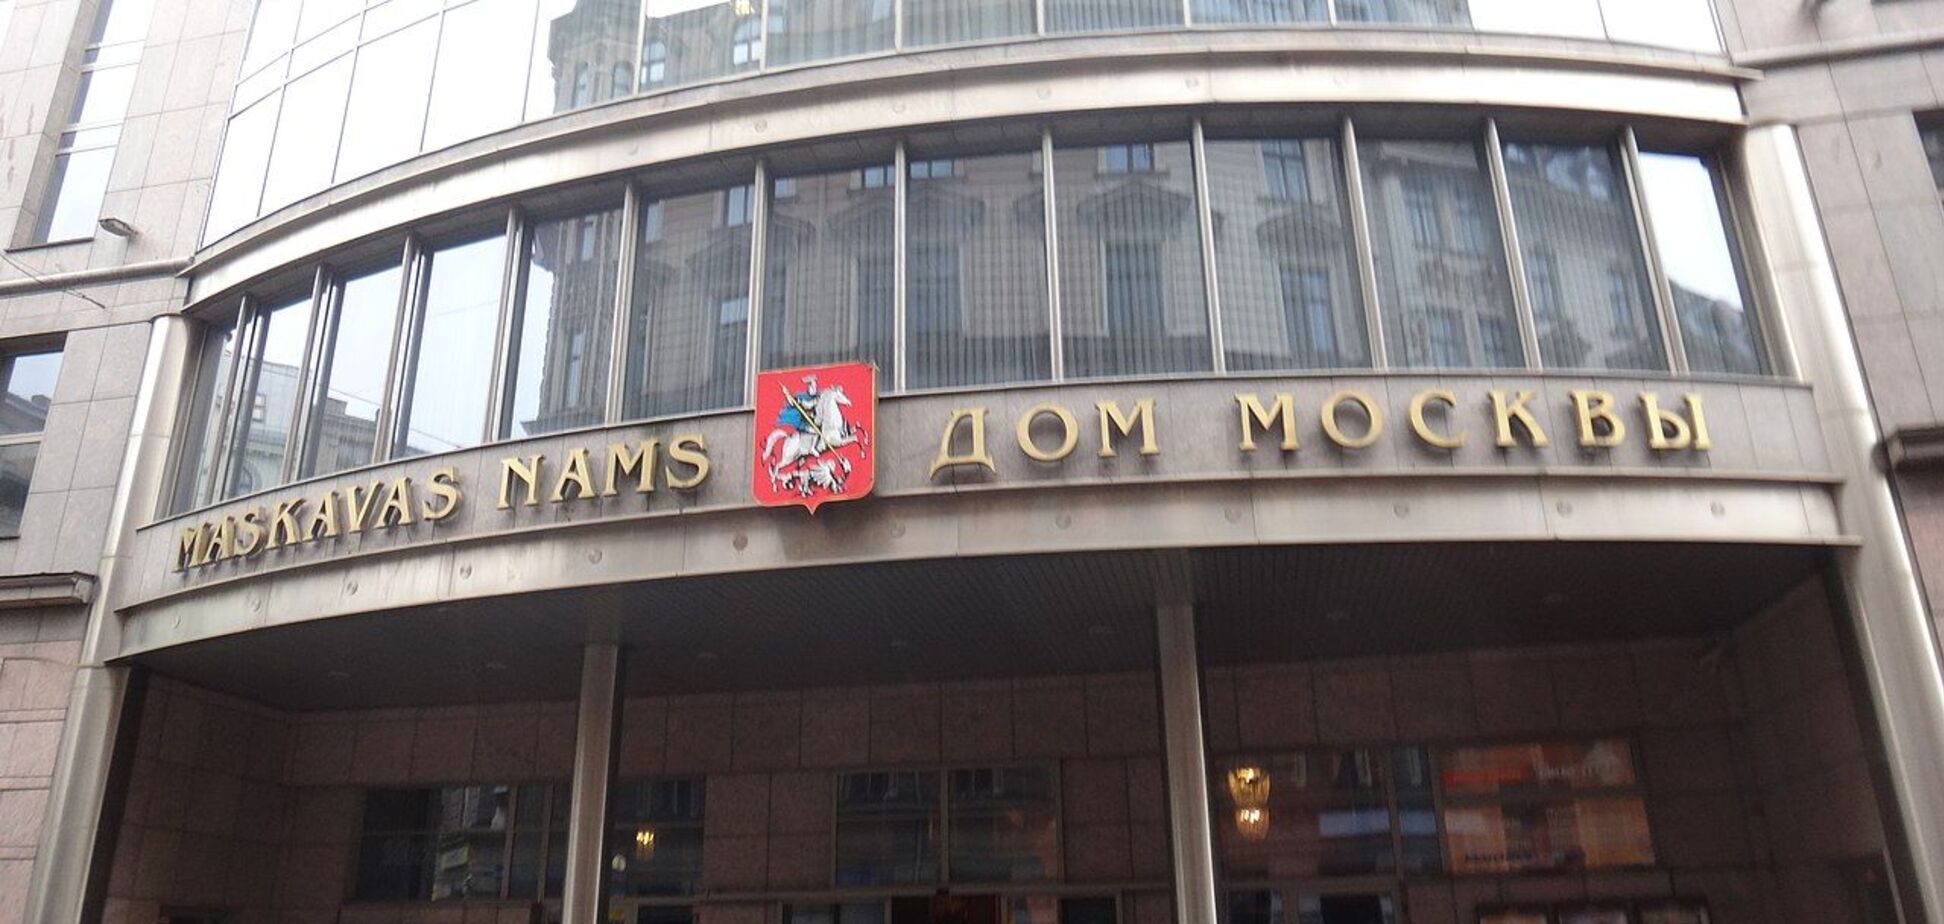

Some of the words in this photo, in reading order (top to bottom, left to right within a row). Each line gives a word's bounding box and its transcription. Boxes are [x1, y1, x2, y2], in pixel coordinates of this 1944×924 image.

[929, 398, 1160, 479] ДОМ
[1236, 390, 1714, 453] МОСКВЫ
[172, 466, 462, 572] MASKAVAS
[496, 433, 713, 509] NAMS
